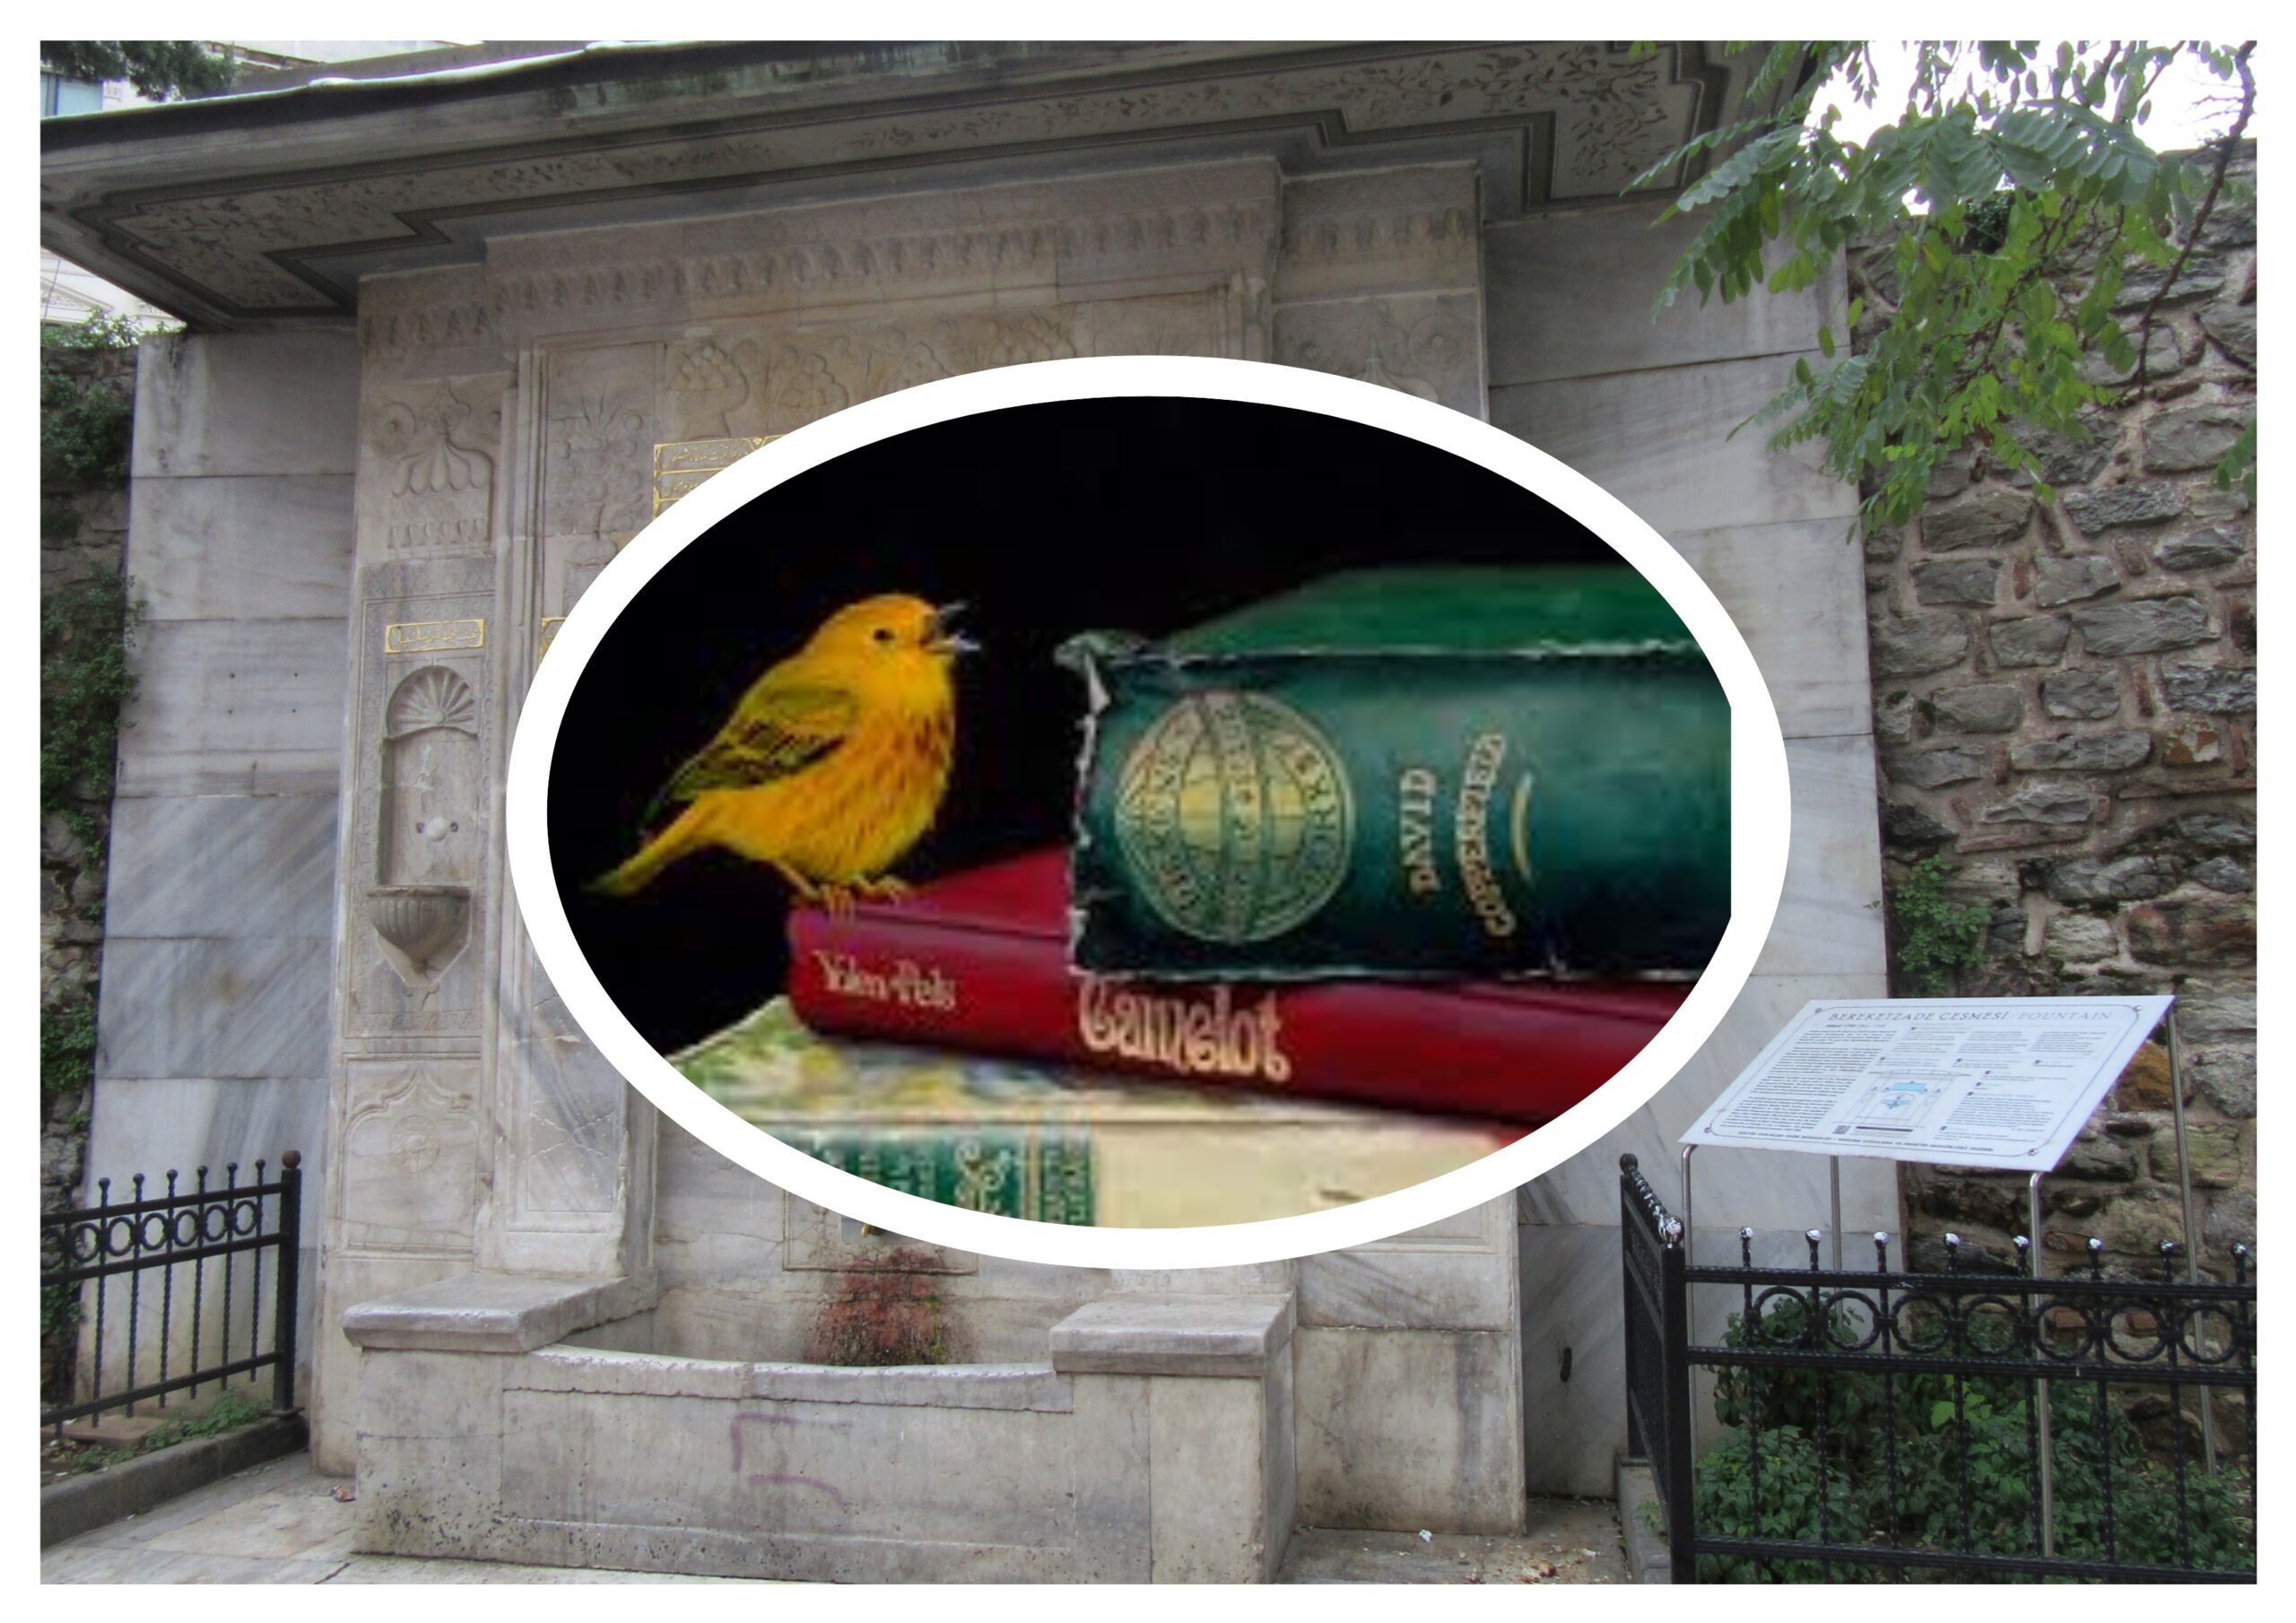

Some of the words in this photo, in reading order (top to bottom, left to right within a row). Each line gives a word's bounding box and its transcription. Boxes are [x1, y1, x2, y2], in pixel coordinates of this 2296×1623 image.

[1400, 768, 1440, 894] DAVID
[1079, 977, 1292, 1082] Camelot
[1828, 1011, 1935, 1021] BEREKETZADE
[2018, 1011, 2114, 1020] FOUNTAIN
